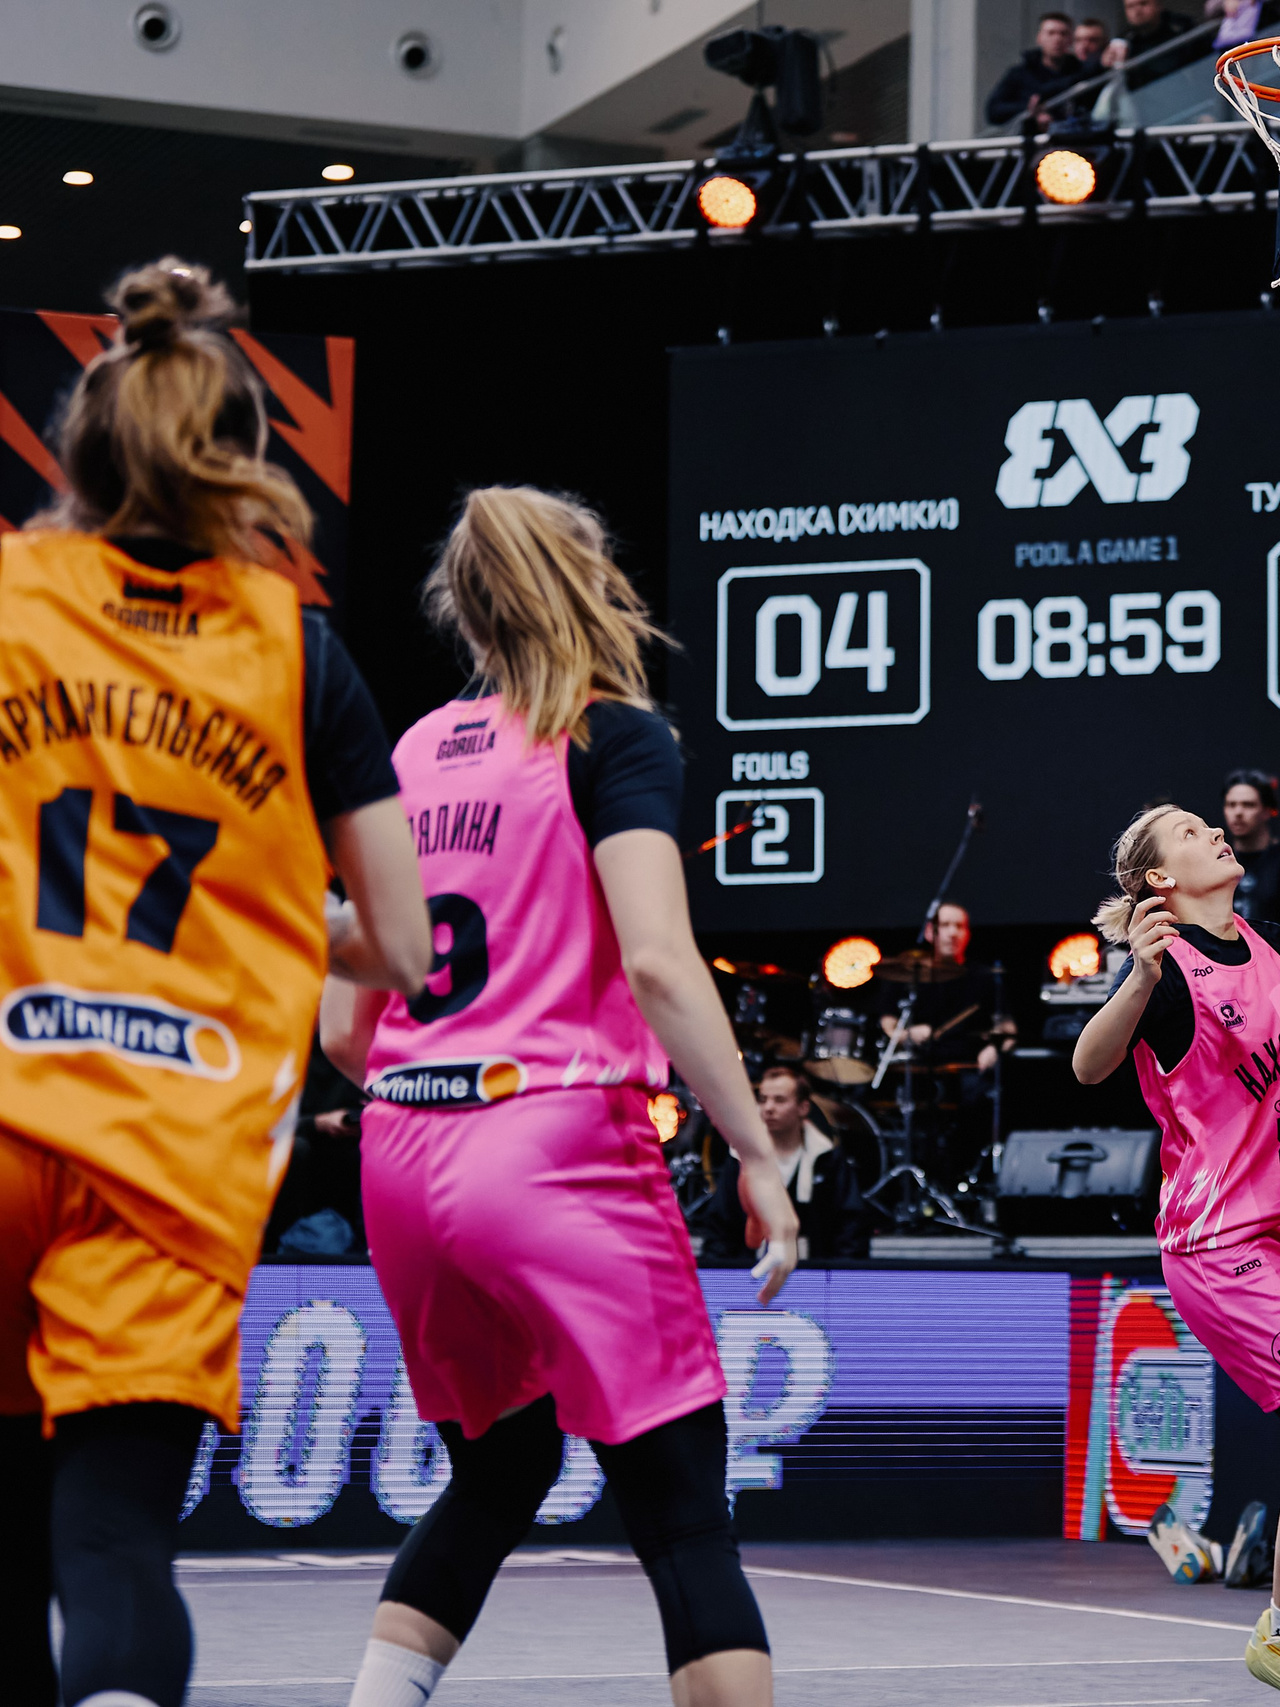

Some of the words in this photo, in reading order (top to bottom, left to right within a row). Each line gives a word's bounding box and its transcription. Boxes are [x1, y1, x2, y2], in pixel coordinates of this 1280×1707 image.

[700, 505, 836, 543] НАХОДКА
[1015, 541, 1075, 568] POOL
[1077, 539, 1094, 565] A
[1096, 535, 1162, 564] GAME
[1165, 535, 1178, 561] 1
[755, 590, 895, 697] 04
[977, 590, 1221, 681] 08:59
[436, 731, 496, 761] GORILLA
[732, 750, 809, 782] FOULS
[409, 802, 501, 857] ЯЛИНА
[751, 805, 790, 866] 2
[37, 787, 219, 955] 17
[407, 893, 489, 1024] 9
[22, 998, 181, 1055] Winline
